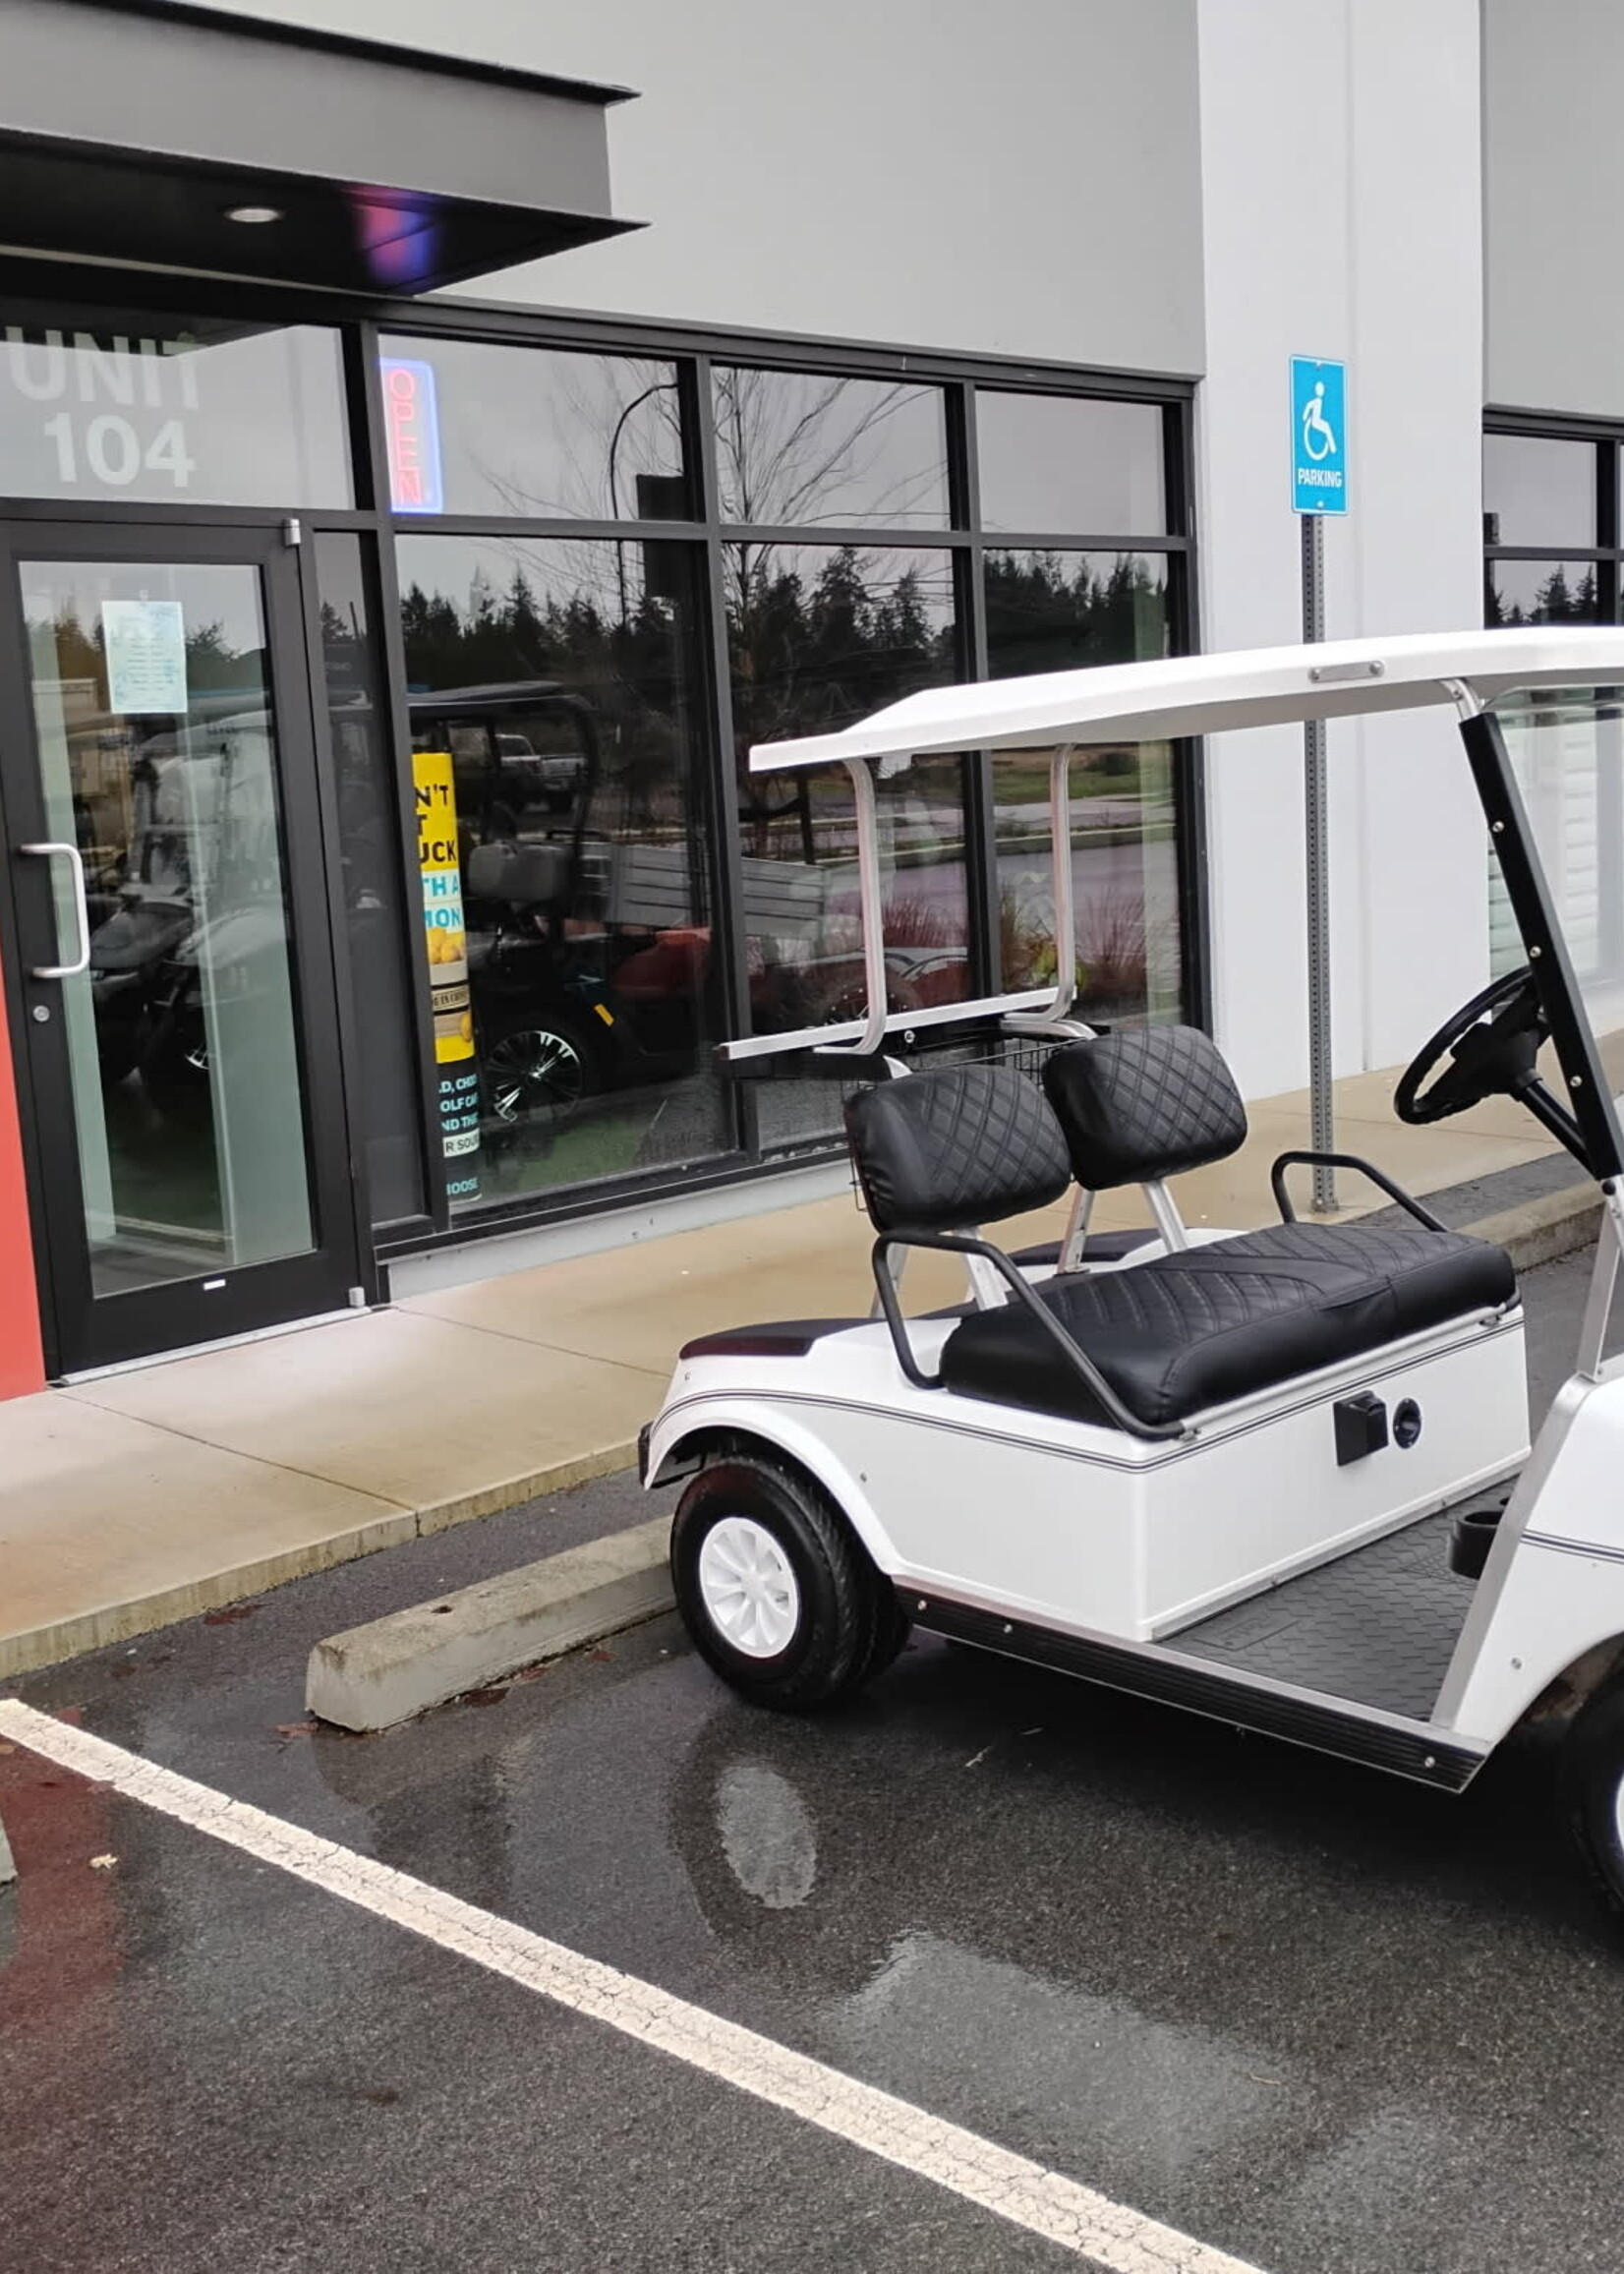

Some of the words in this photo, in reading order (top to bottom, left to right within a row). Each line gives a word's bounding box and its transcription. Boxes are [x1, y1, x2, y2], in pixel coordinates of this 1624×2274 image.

[5, 325, 204, 410] UNIT
[44, 412, 197, 488] 104
[388, 367, 423, 505] OPEN
[1298, 468, 1342, 488] PARKING
